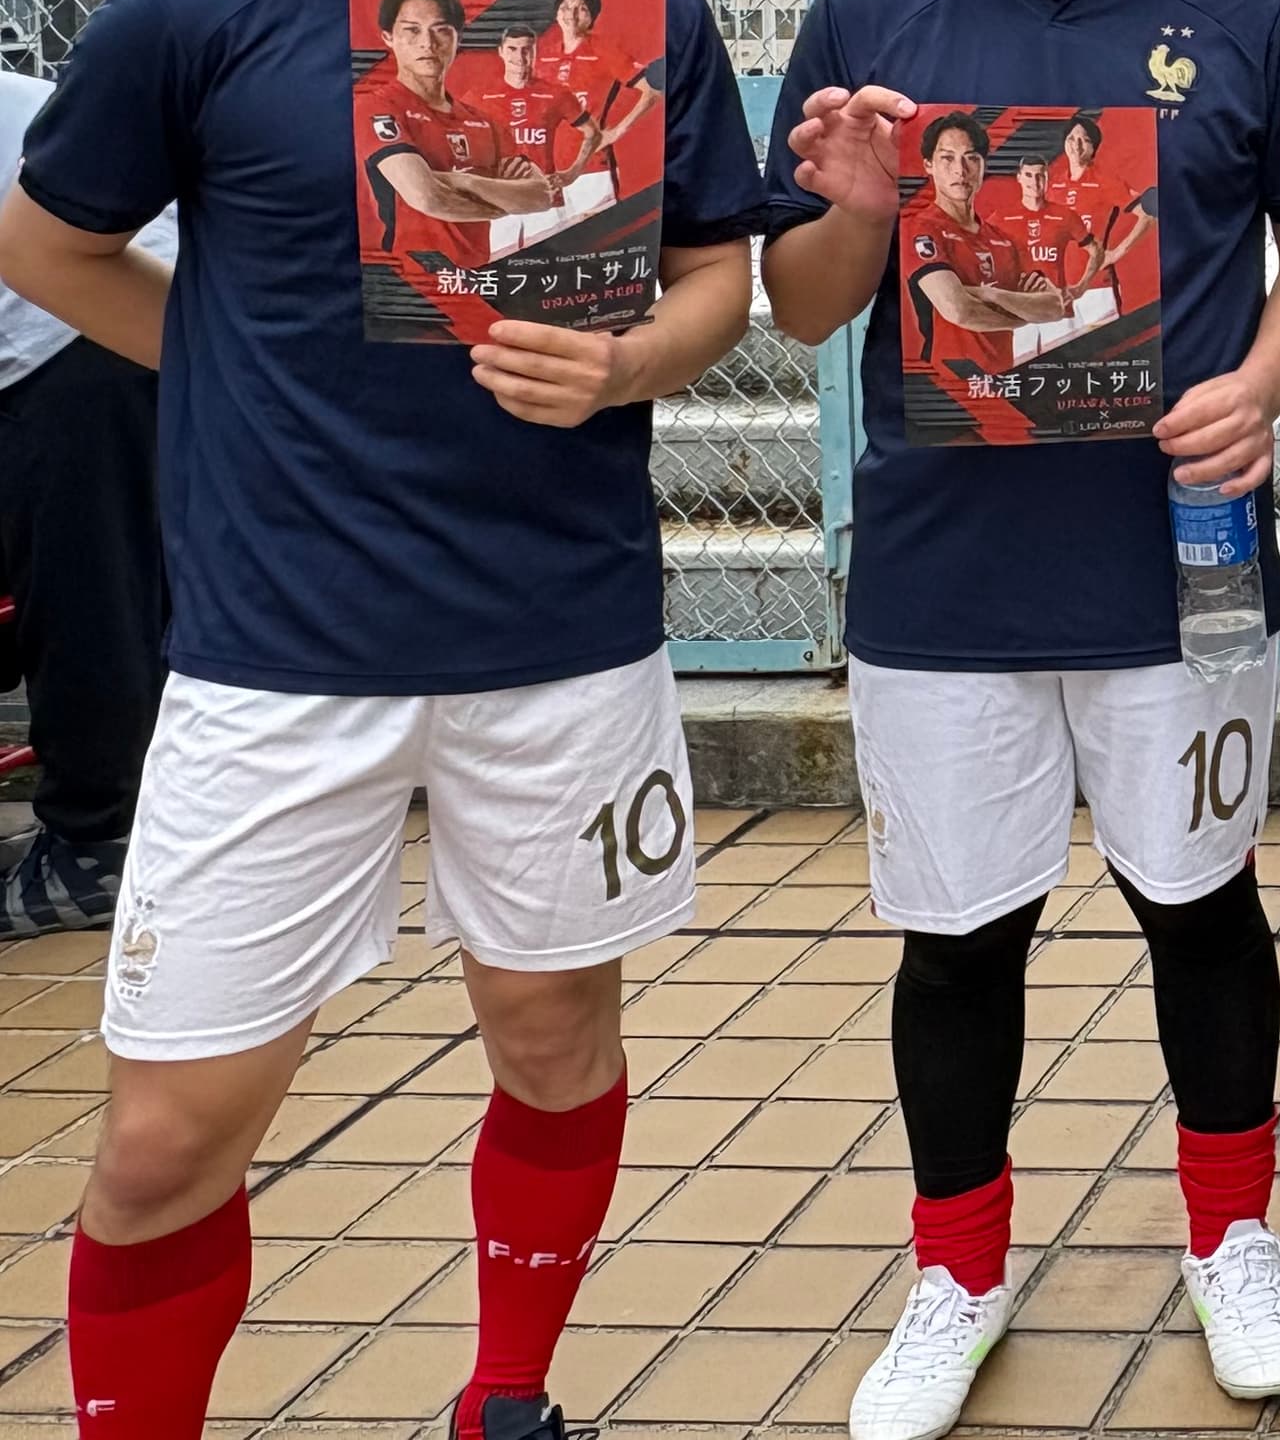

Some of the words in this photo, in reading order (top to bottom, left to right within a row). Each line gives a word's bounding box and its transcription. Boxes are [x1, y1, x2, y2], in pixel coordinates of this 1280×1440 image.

[437, 256, 652, 297] 就活フットサル
[967, 370, 1157, 399] 就活フットサル
[1177, 717, 1253, 834] 10
[578, 767, 687, 901] 10
